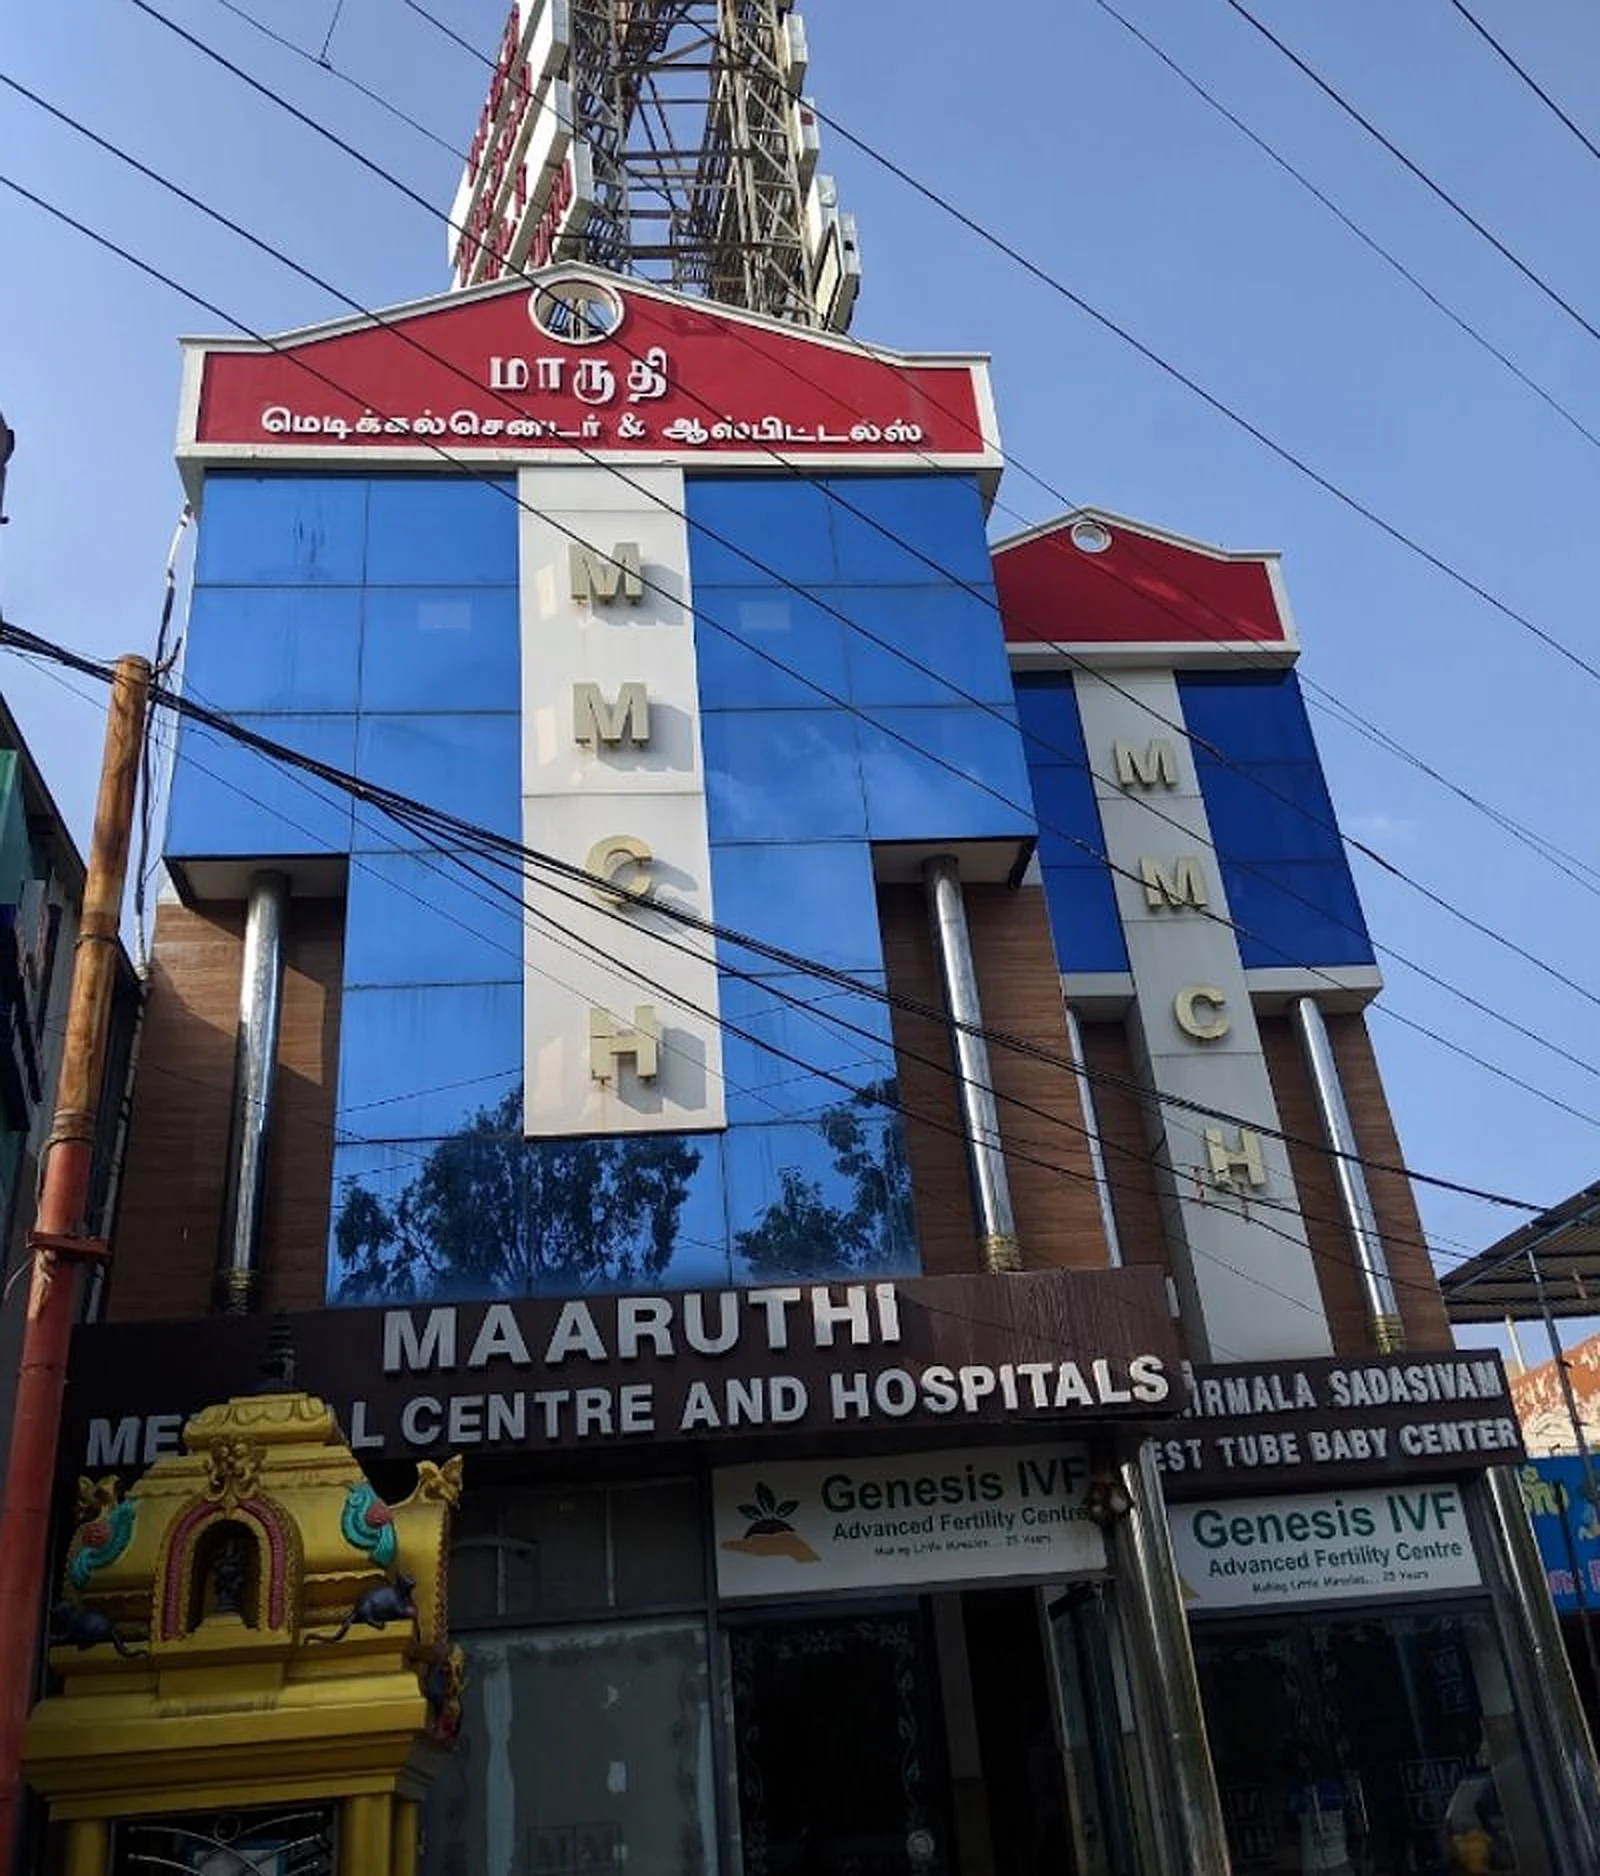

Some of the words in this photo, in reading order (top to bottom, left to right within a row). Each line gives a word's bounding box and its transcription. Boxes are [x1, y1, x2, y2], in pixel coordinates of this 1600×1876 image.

[489, 346, 668, 405] மாருதி
[617, 412, 647, 438] &
[382, 1282, 900, 1373] MAARUTHI
[401, 1384, 656, 1445] CENTRE
[681, 1374, 808, 1431] AND
[831, 1354, 1170, 1421] HOSPITALS
[1189, 1372, 1318, 1417] IRMALA
[1327, 1360, 1502, 1407] SADASIVAM
[1152, 1437, 1202, 1472] EST
[1216, 1432, 1301, 1469] TUBE
[1308, 1426, 1389, 1462] BABY
[1400, 1417, 1519, 1456] CENTER
[820, 1464, 1003, 1513] Genesis
[1018, 1457, 1087, 1498] IVF
[833, 1520, 934, 1542] Advanced
[940, 1508, 1015, 1531] Fertility
[1193, 1498, 1377, 1549] Genesis
[1387, 1490, 1458, 1535] IVF
[1208, 1553, 1311, 1579] Advanced
[1314, 1547, 1391, 1572] Fertility
[1396, 1540, 1463, 1563] Centre
